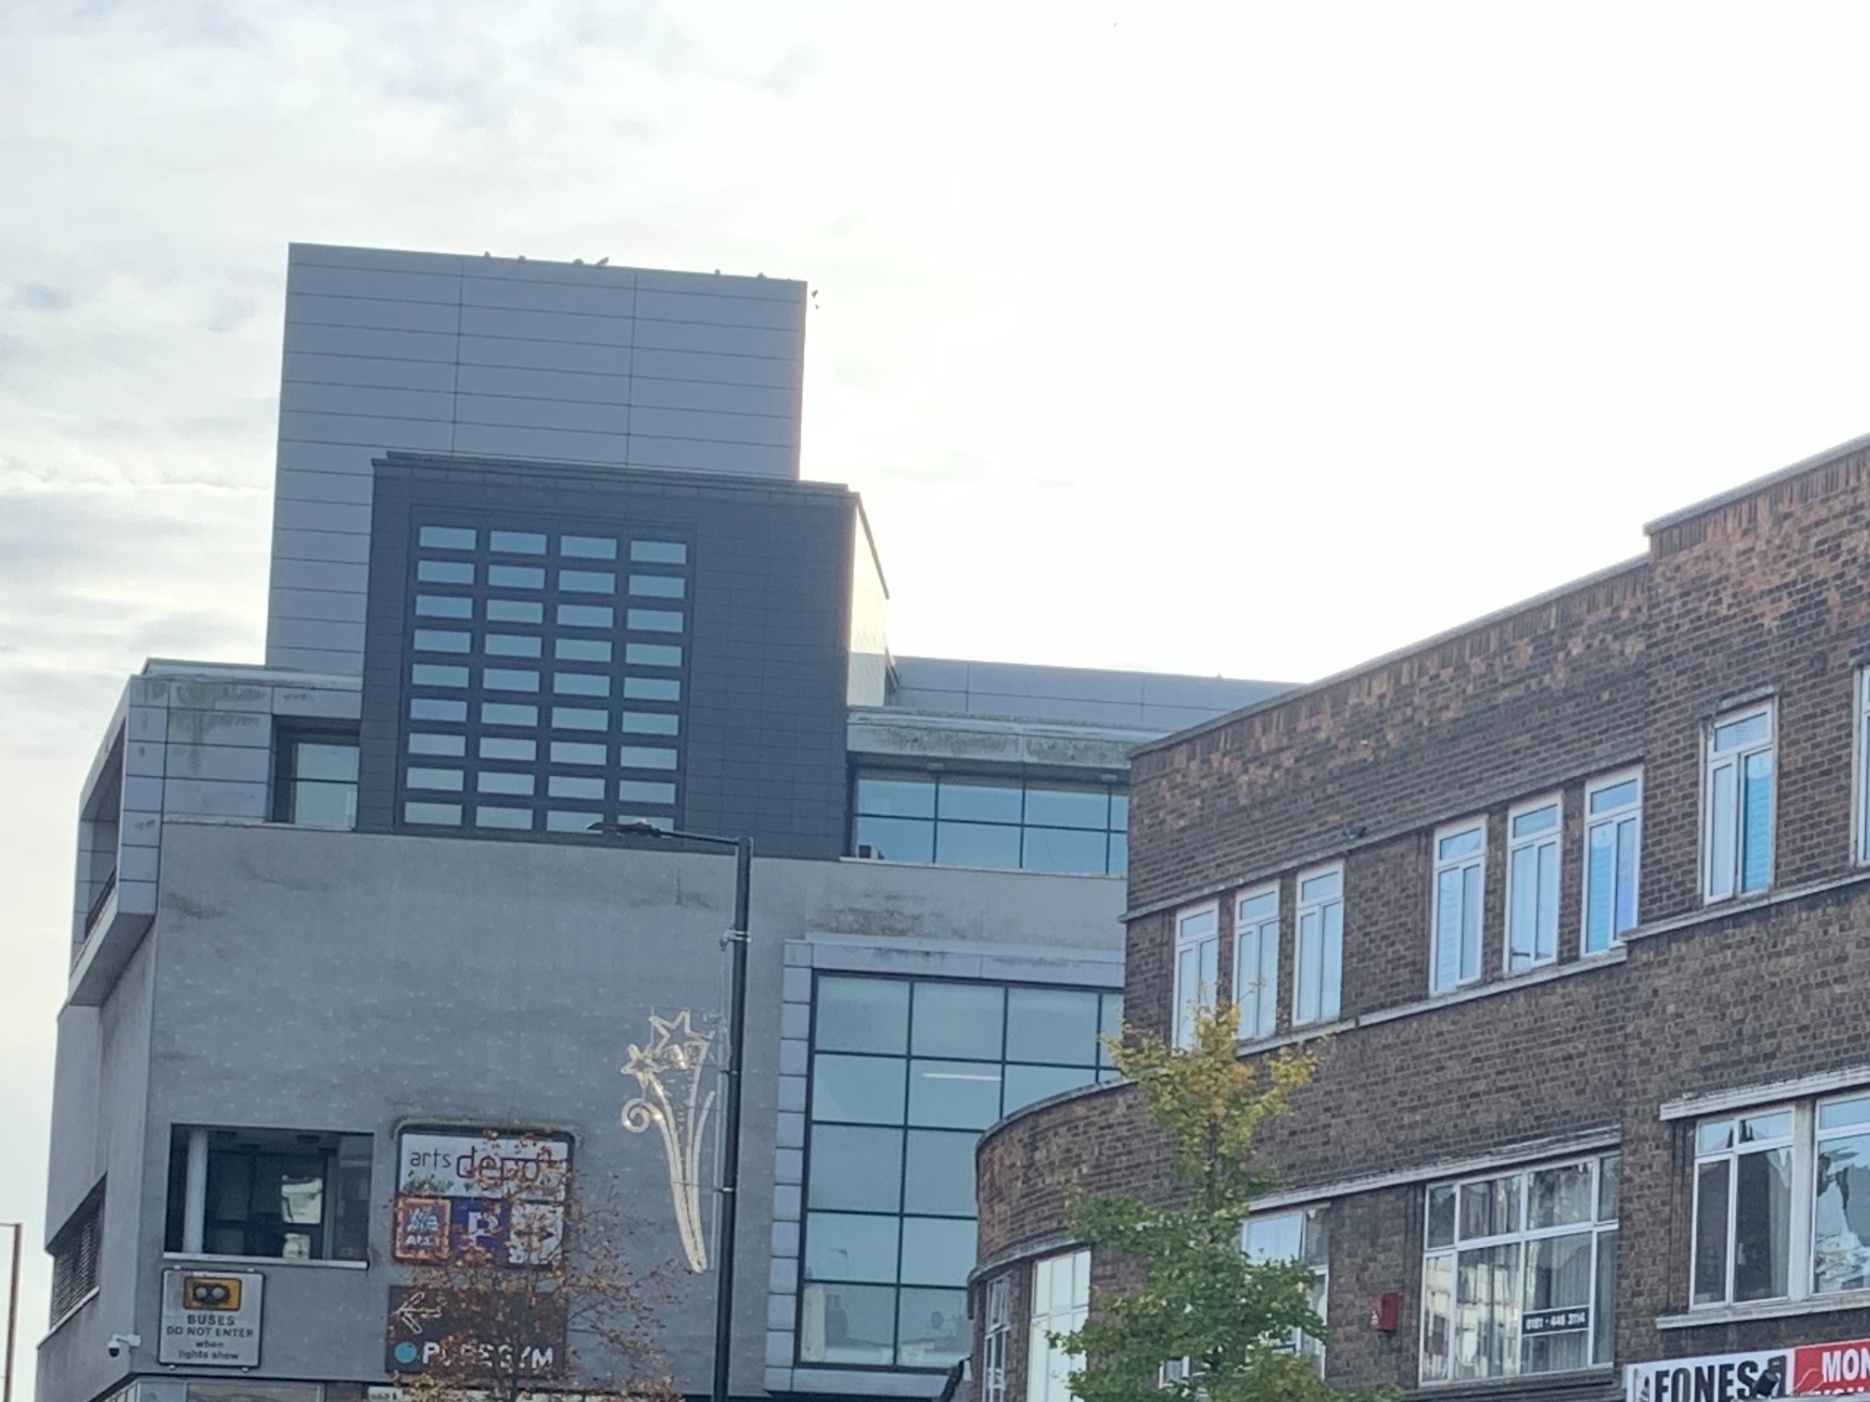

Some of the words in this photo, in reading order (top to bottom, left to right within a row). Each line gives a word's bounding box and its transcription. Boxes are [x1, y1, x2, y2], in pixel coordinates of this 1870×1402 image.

[409, 1149, 452, 1168] arts
[187, 1314, 236, 1327] BUSES
[166, 1326, 184, 1336] DO
[187, 1327, 213, 1337] NOT
[215, 1328, 254, 1338] ENTER
[196, 1340, 225, 1348] when
[178, 1350, 209, 1360] lights
[211, 1351, 239, 1360] show
